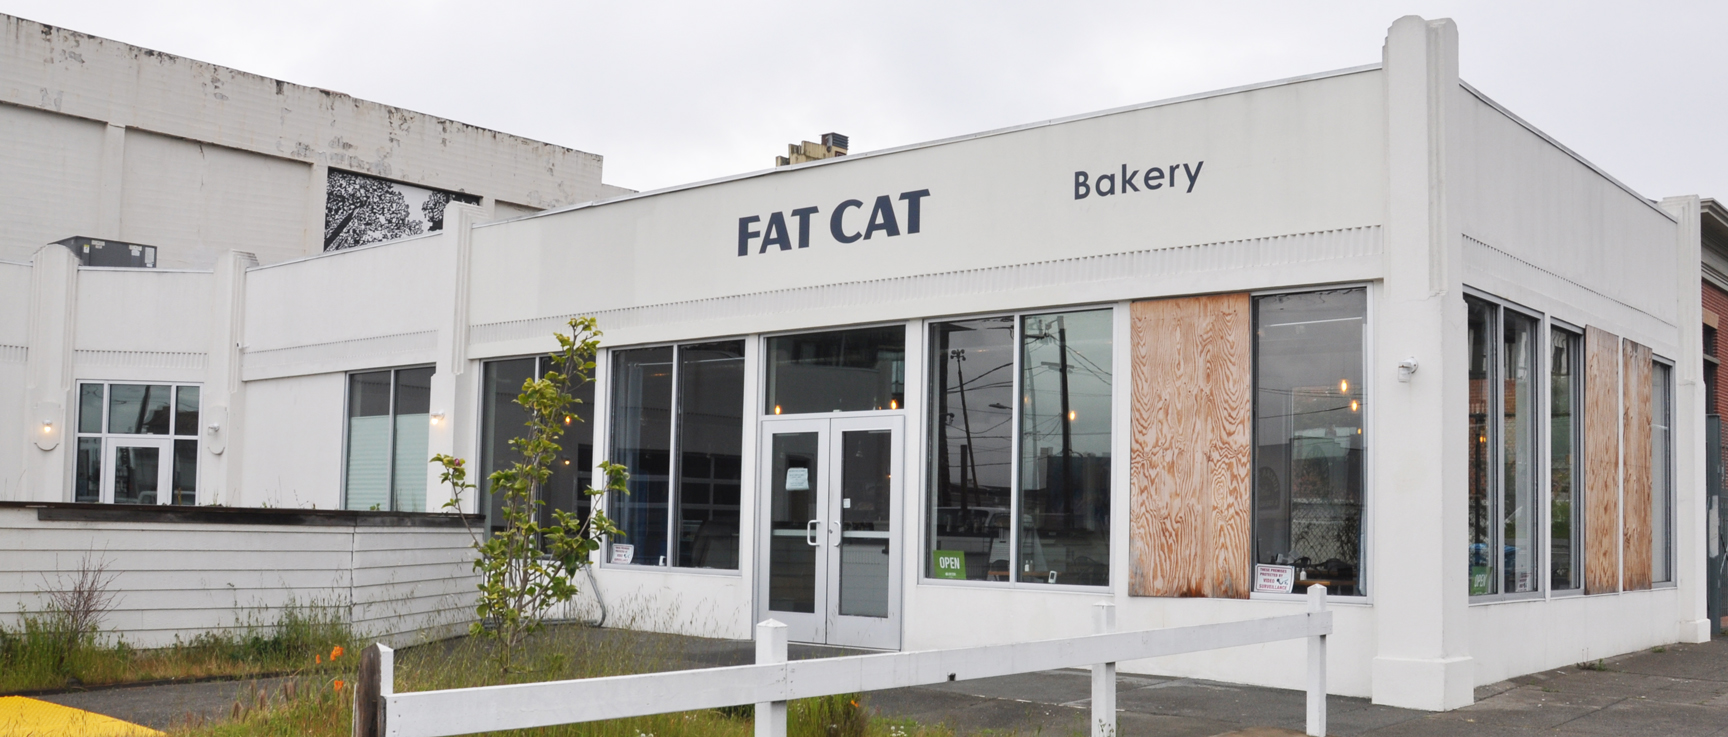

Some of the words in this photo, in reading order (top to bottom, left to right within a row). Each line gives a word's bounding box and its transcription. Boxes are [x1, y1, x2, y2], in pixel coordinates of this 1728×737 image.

[1074, 161, 1205, 201] Bakery
[737, 206, 819, 257] FAT
[829, 188, 931, 244] CAT
[939, 556, 960, 569] OPEN
[1474, 574, 1487, 587] OPEN
